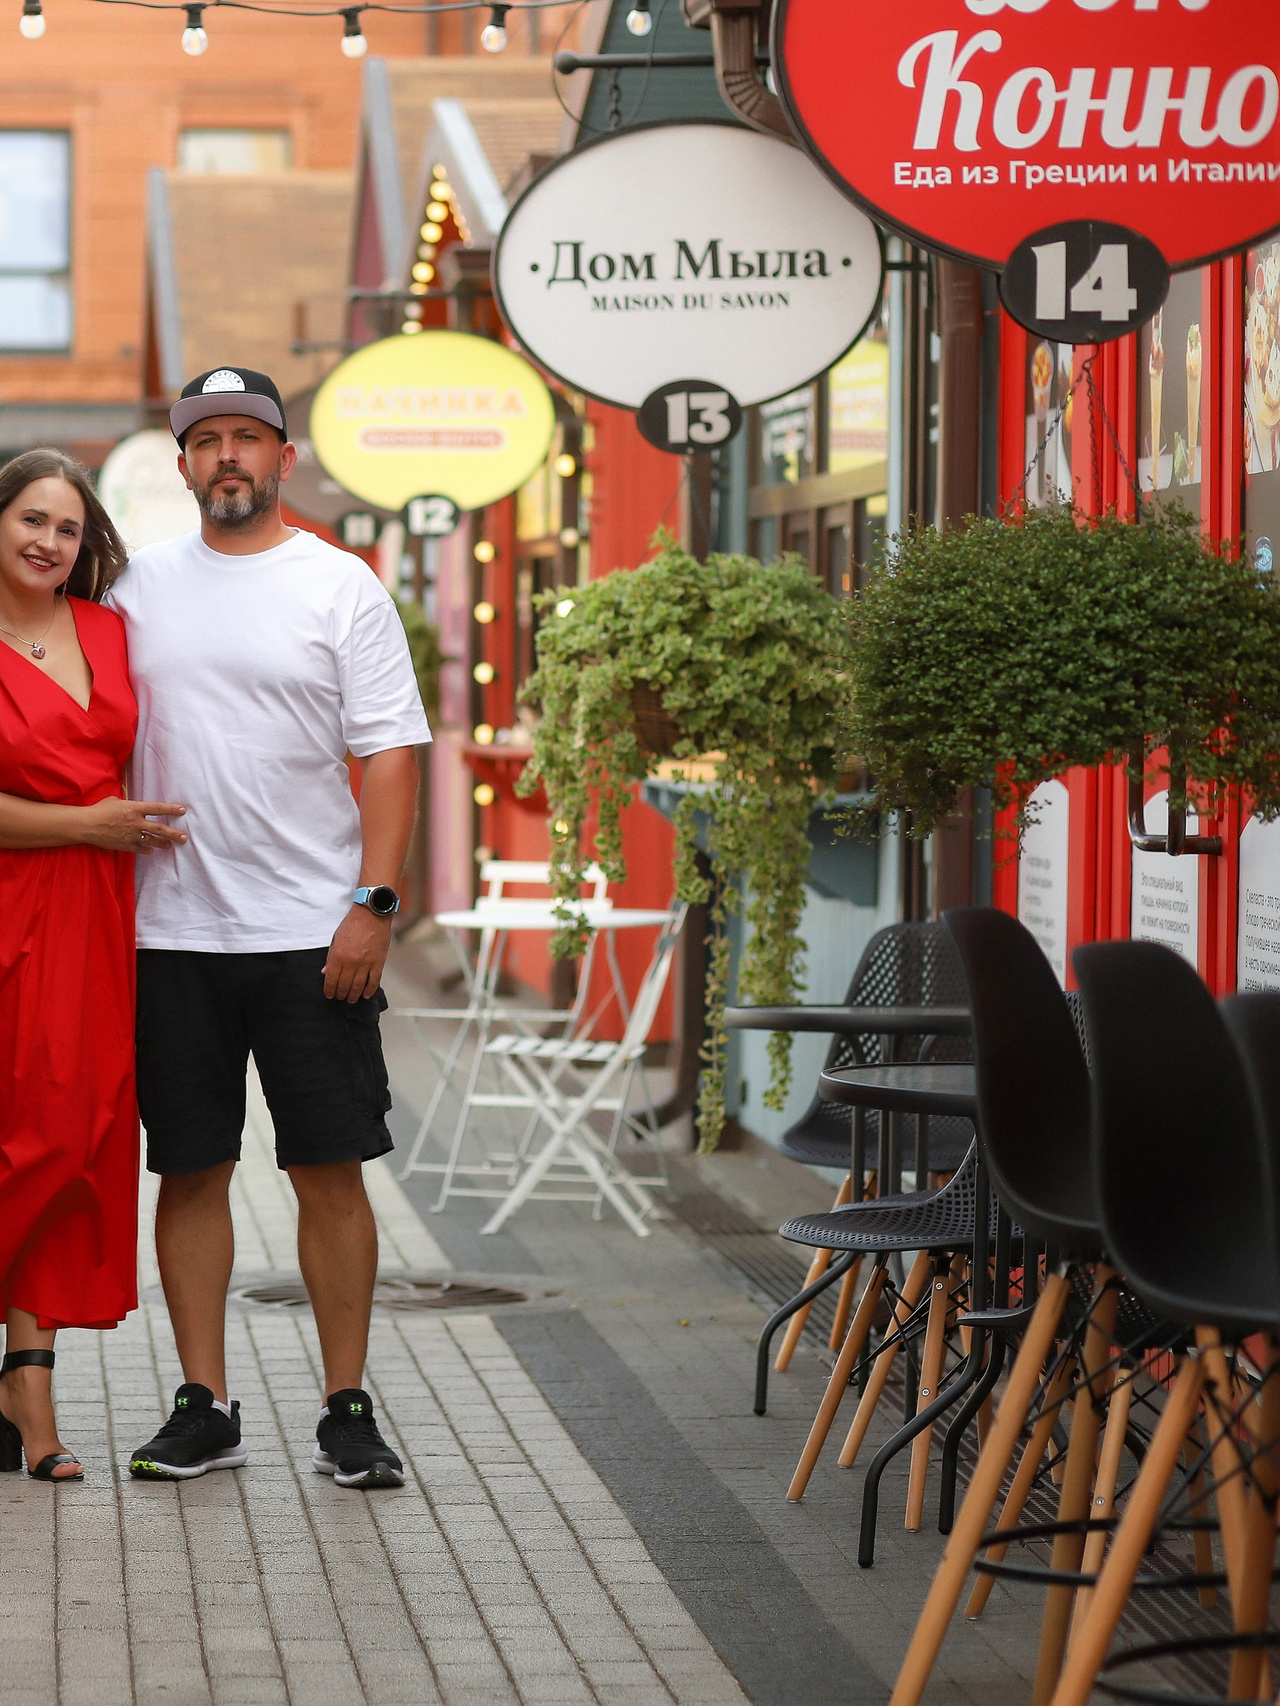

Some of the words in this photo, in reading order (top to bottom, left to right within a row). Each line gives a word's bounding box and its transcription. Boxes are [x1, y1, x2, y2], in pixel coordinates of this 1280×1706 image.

[897, 29, 1280, 152] Конно
[894, 161, 953, 188] Еда
[962, 165, 1000, 184] из
[1009, 160, 1128, 189] Греции
[1138, 164, 1157, 183] и
[1168, 158, 1280, 184] Италии
[547, 240, 656, 289] Дом
[674, 238, 831, 281] Мыла
[1031, 240, 1138, 322] 14
[591, 294, 675, 312] MAISON
[683, 293, 714, 311] DU
[720, 291, 791, 309] SAVON
[664, 390, 732, 446] 13
[409, 496, 455, 536] 12
